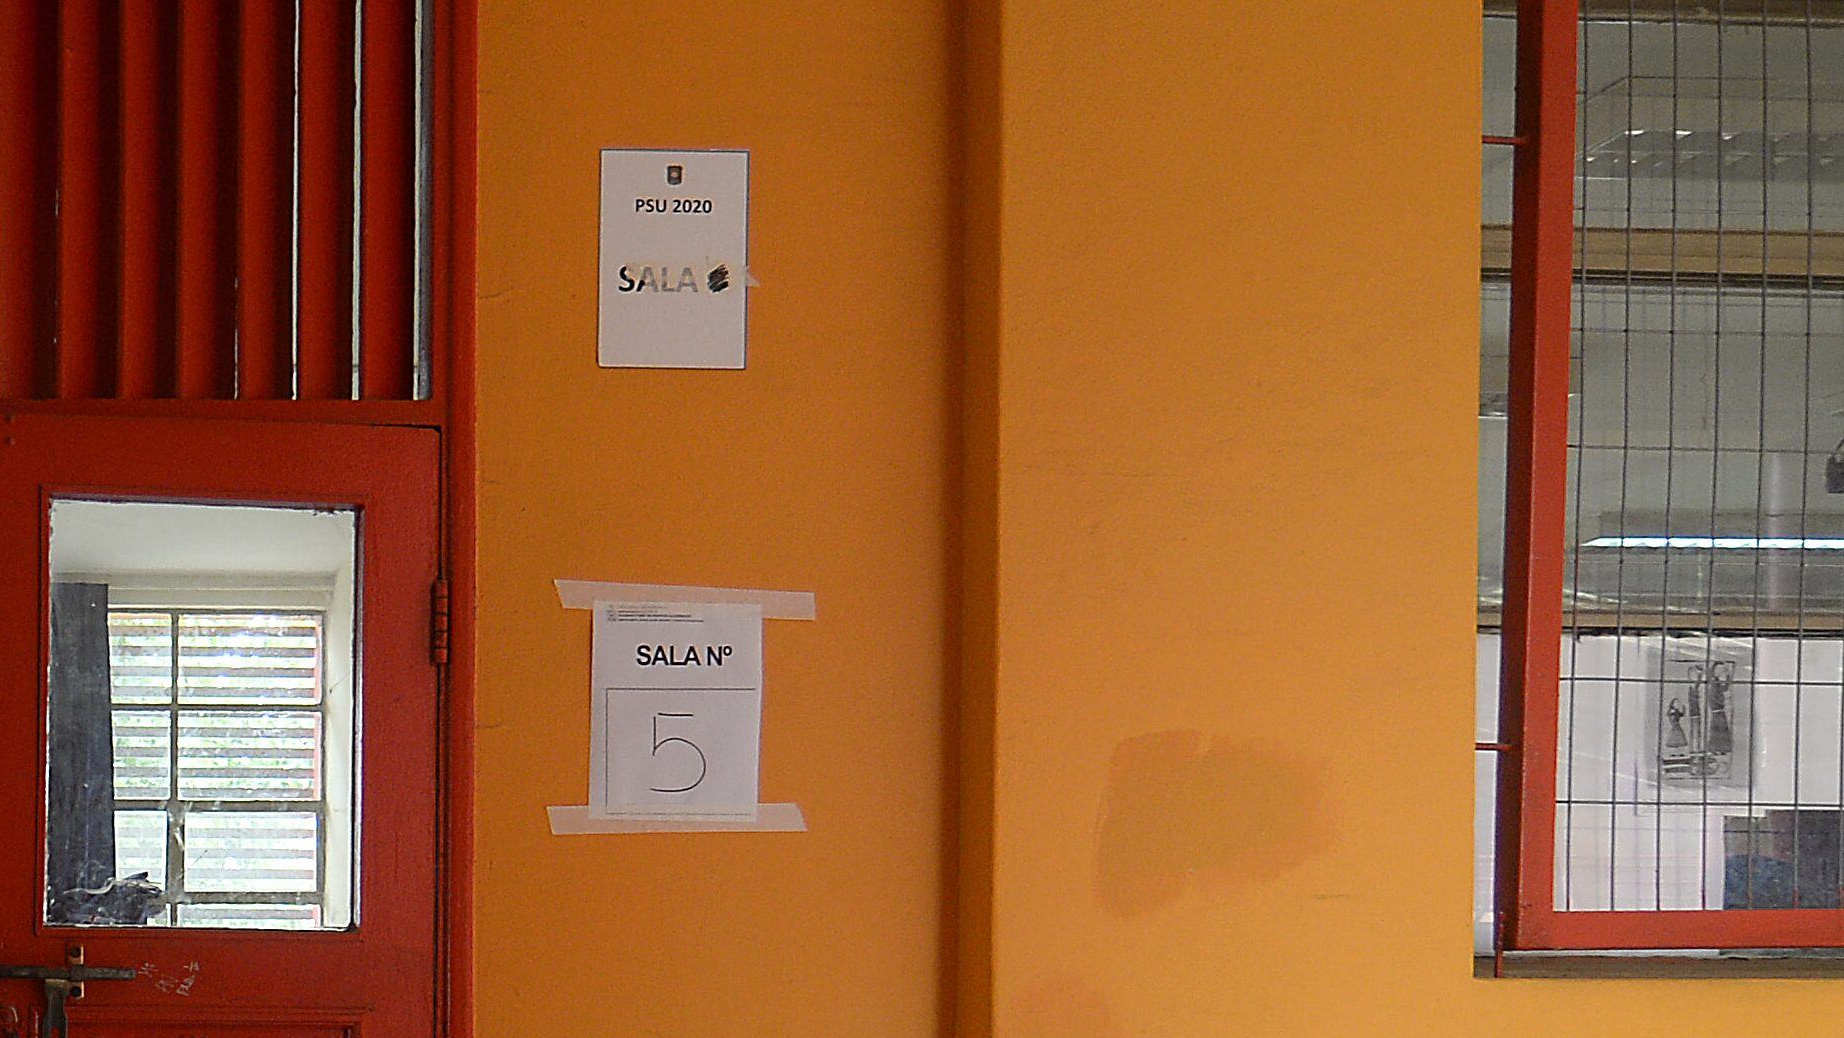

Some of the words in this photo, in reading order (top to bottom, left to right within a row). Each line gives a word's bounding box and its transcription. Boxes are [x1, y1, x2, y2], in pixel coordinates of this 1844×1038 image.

[635, 199, 667, 213] PSU
[673, 199, 712, 213] 2020
[618, 265, 699, 293] SALA
[636, 645, 701, 666] SALA
[649, 712, 707, 793] 5
